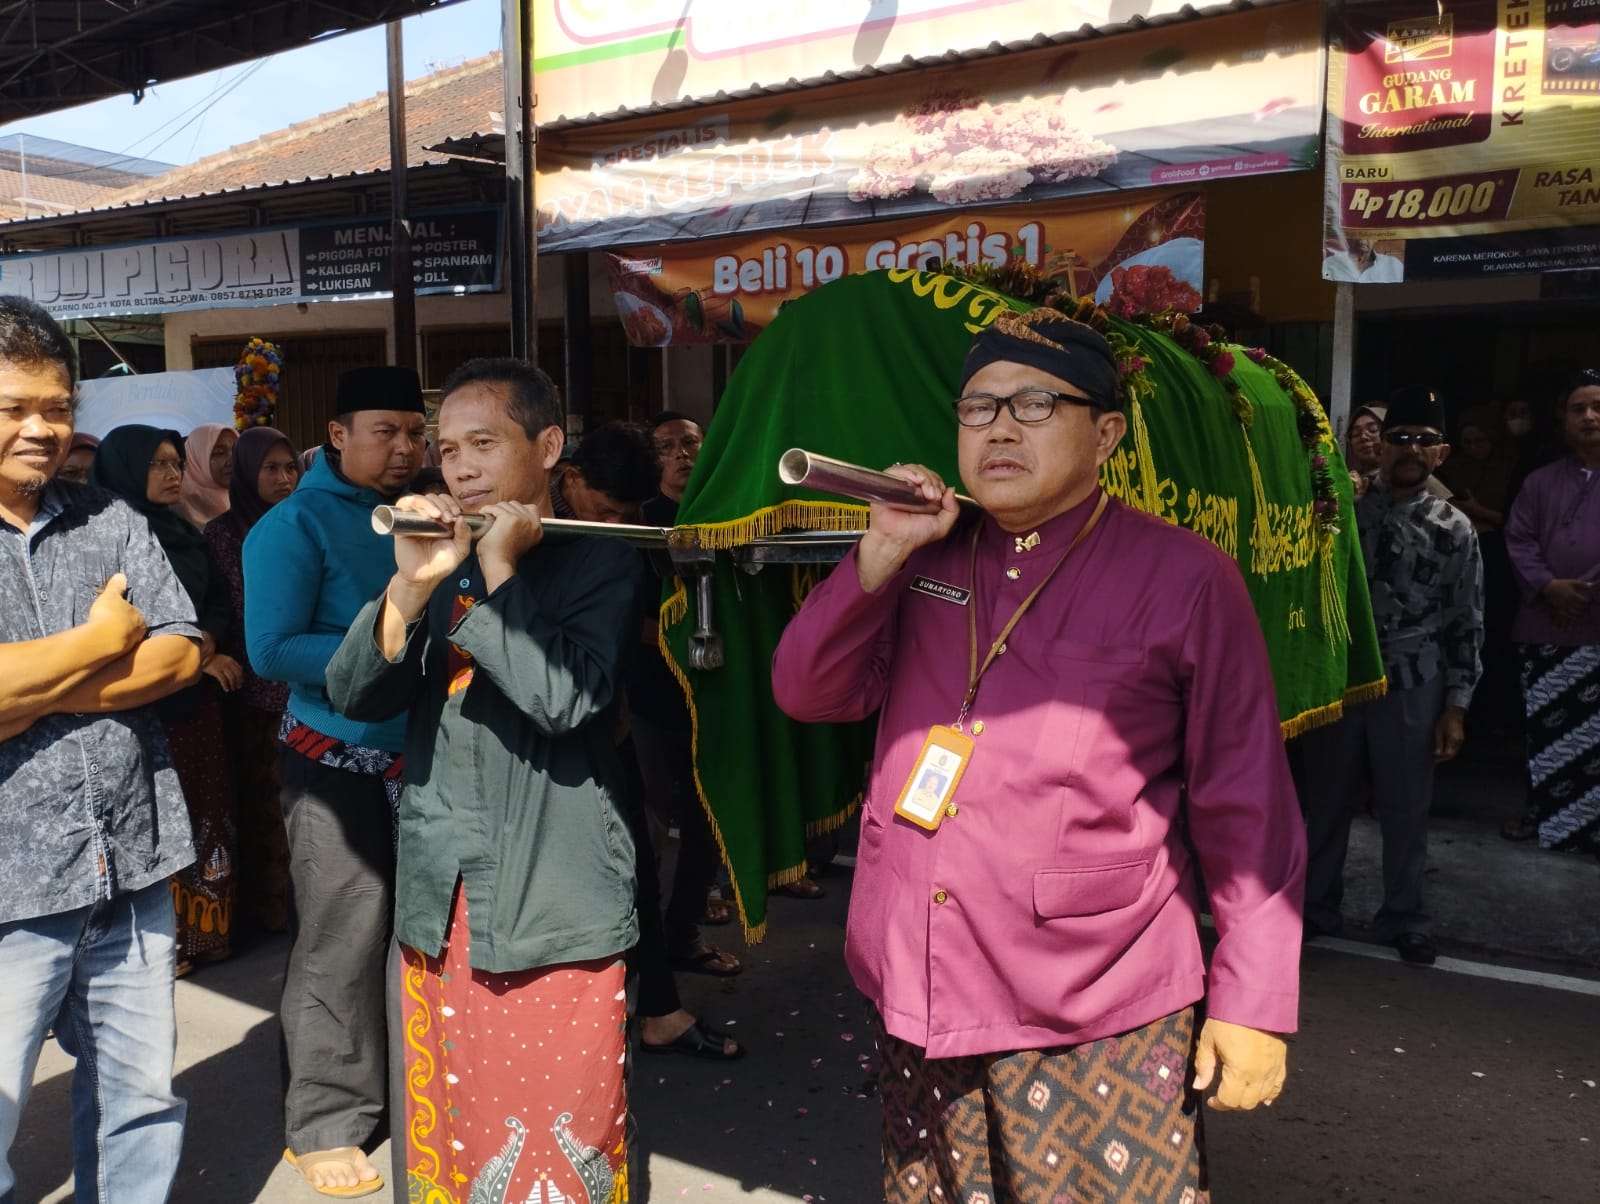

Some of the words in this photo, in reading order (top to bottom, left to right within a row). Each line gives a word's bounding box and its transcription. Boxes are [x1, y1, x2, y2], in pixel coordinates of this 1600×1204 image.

[1383, 68, 1451, 88] GUDANG
[1359, 79, 1477, 114] GARAM
[1357, 110, 1474, 139] International
[654, 127, 834, 202] GEPREK
[1345, 167, 1389, 179] BARU
[1533, 167, 1593, 188] RASA
[1349, 188, 1384, 219] Rp
[1386, 180, 1496, 220] 18.000
[334, 221, 442, 245] MENAL
[367, 246, 393, 258] FOT
[424, 239, 477, 253] POSTER
[424, 254, 493, 268] SPANRAM
[713, 244, 787, 294] Beli
[796, 245, 845, 286] 10
[1018, 223, 1039, 267] 1
[1433, 253, 1471, 263] KARENA
[319, 277, 371, 291] LUKISAN
[424, 271, 449, 283] DLL
[110, 298, 132, 308] KOTA
[210, 291, 235, 301] 0857
[919, 580, 962, 598] SUMARYONO
